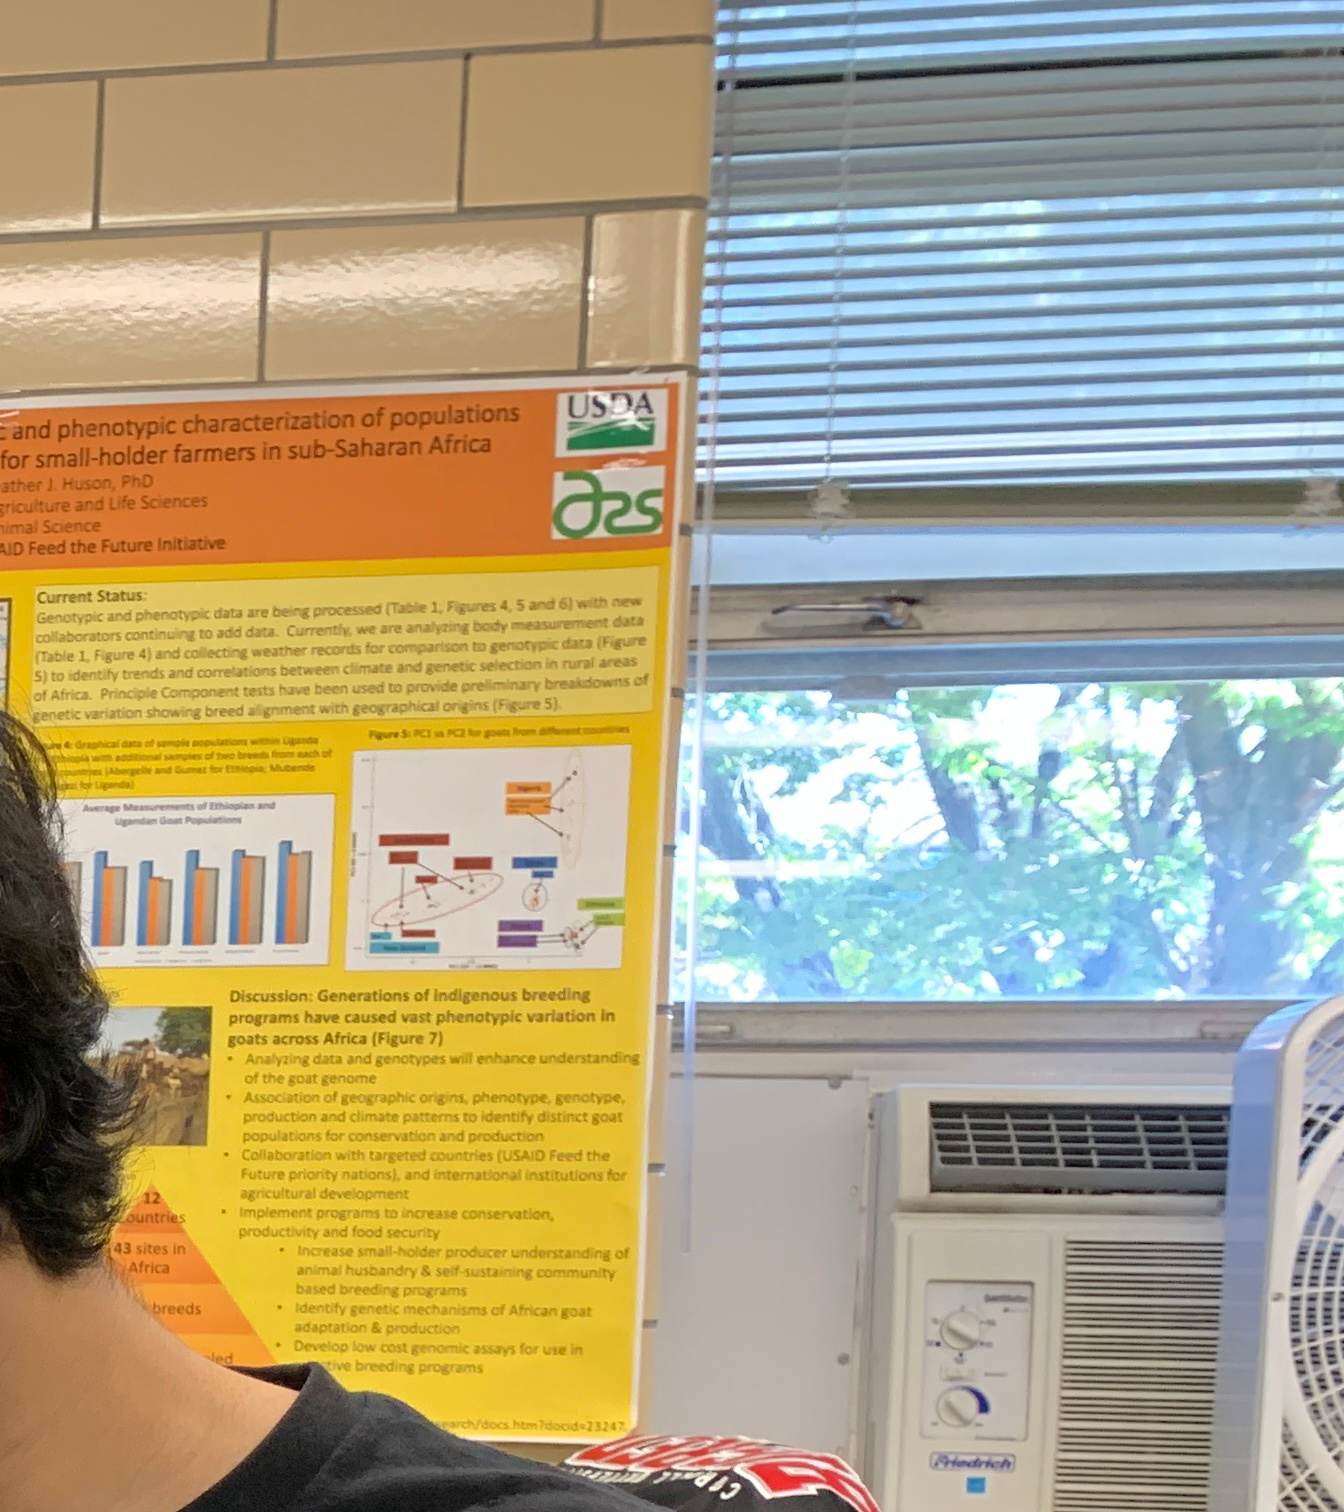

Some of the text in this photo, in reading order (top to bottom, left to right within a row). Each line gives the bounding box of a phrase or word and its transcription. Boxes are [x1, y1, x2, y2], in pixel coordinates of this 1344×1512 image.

[566, 392, 655, 420] USDA
[13, 419, 54, 441] and
[58, 415, 178, 447] phenotypic
[182, 410, 355, 435] characterization
[359, 406, 384, 428] of
[388, 403, 520, 436] populations
[0, 449, 31, 470] for
[35, 441, 168, 469] small-holder
[172, 443, 257, 464] farmers
[261, 441, 283, 461] in
[287, 437, 421, 460] sub-Saharan
[424, 433, 492, 455] Africa
[45, 477, 58, 492] J.
[60, 477, 117, 492] Huson,
[119, 473, 154, 489] PhD
[73, 496, 105, 513] and
[107, 494, 137, 511] Life
[139, 494, 209, 510] Sciences
[41, 519, 102, 535] Science
[27, 539, 67, 556] Feed
[69, 538, 97, 555] the
[99, 538, 153, 554] Future
[156, 535, 227, 552] Initiative
[36, 589, 147, 605] Current Status:
[229, 987, 591, 1005] Discussion: Generations of indigenous breeding
[228, 1008, 616, 1028] programs have caused vast phenotypic variation in
[227, 1030, 444, 1049] goats across Africa (Figure 7)
[143, 1192, 161, 1204] 12
[113, 1241, 187, 1255] 43 sites in
[127, 1261, 170, 1275] Africa
[152, 1301, 202, 1315] breeds
[933, 1453, 1013, 1470] Friedrich
